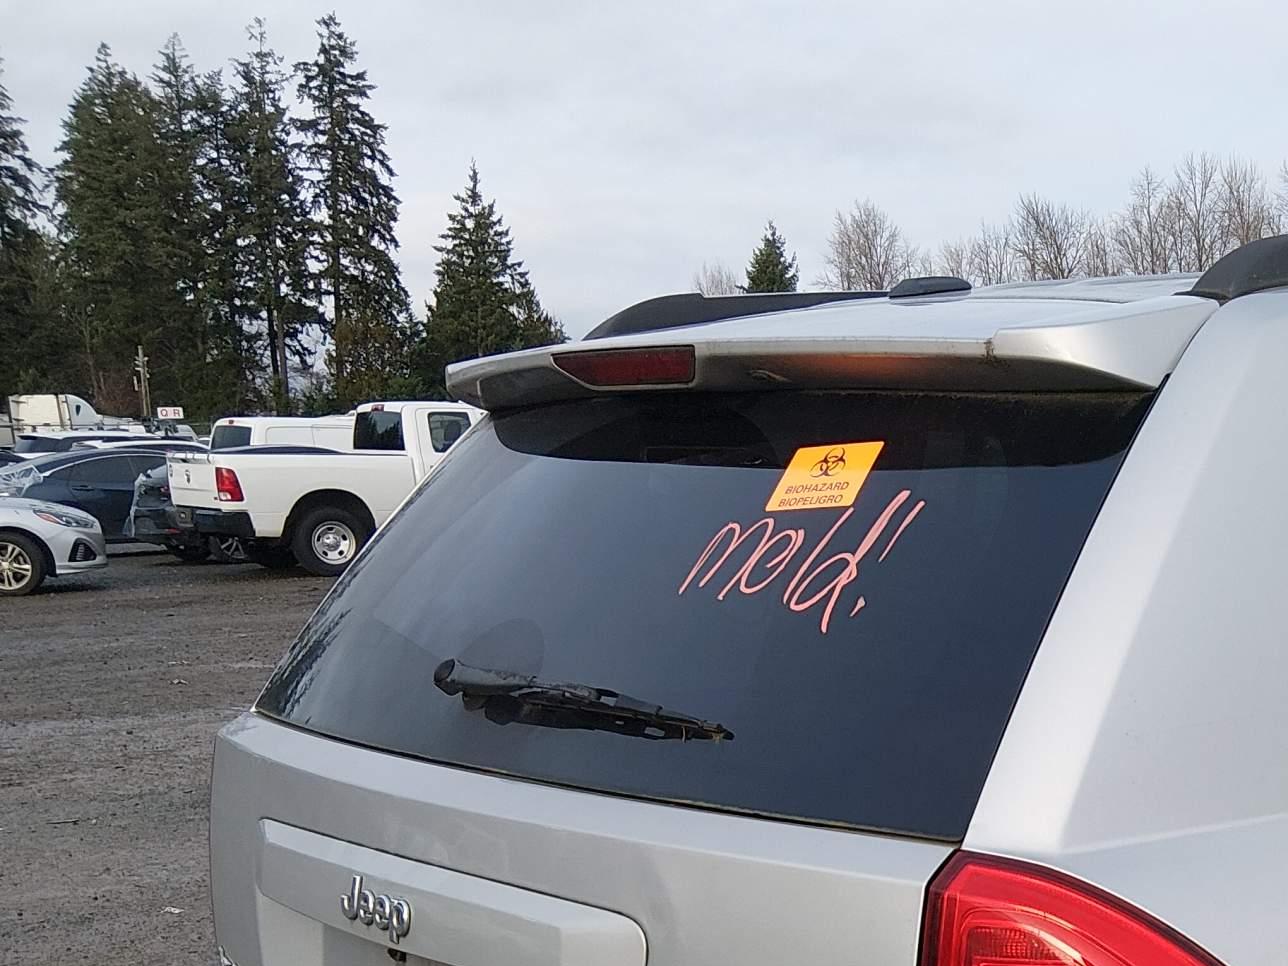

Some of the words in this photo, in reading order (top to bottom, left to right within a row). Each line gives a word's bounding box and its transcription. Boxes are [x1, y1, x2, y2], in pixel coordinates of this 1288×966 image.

[785, 481, 850, 495] BIOHAZARD
[778, 494, 843, 507] BIOPELIGRO
[340, 874, 412, 945] Jeep
